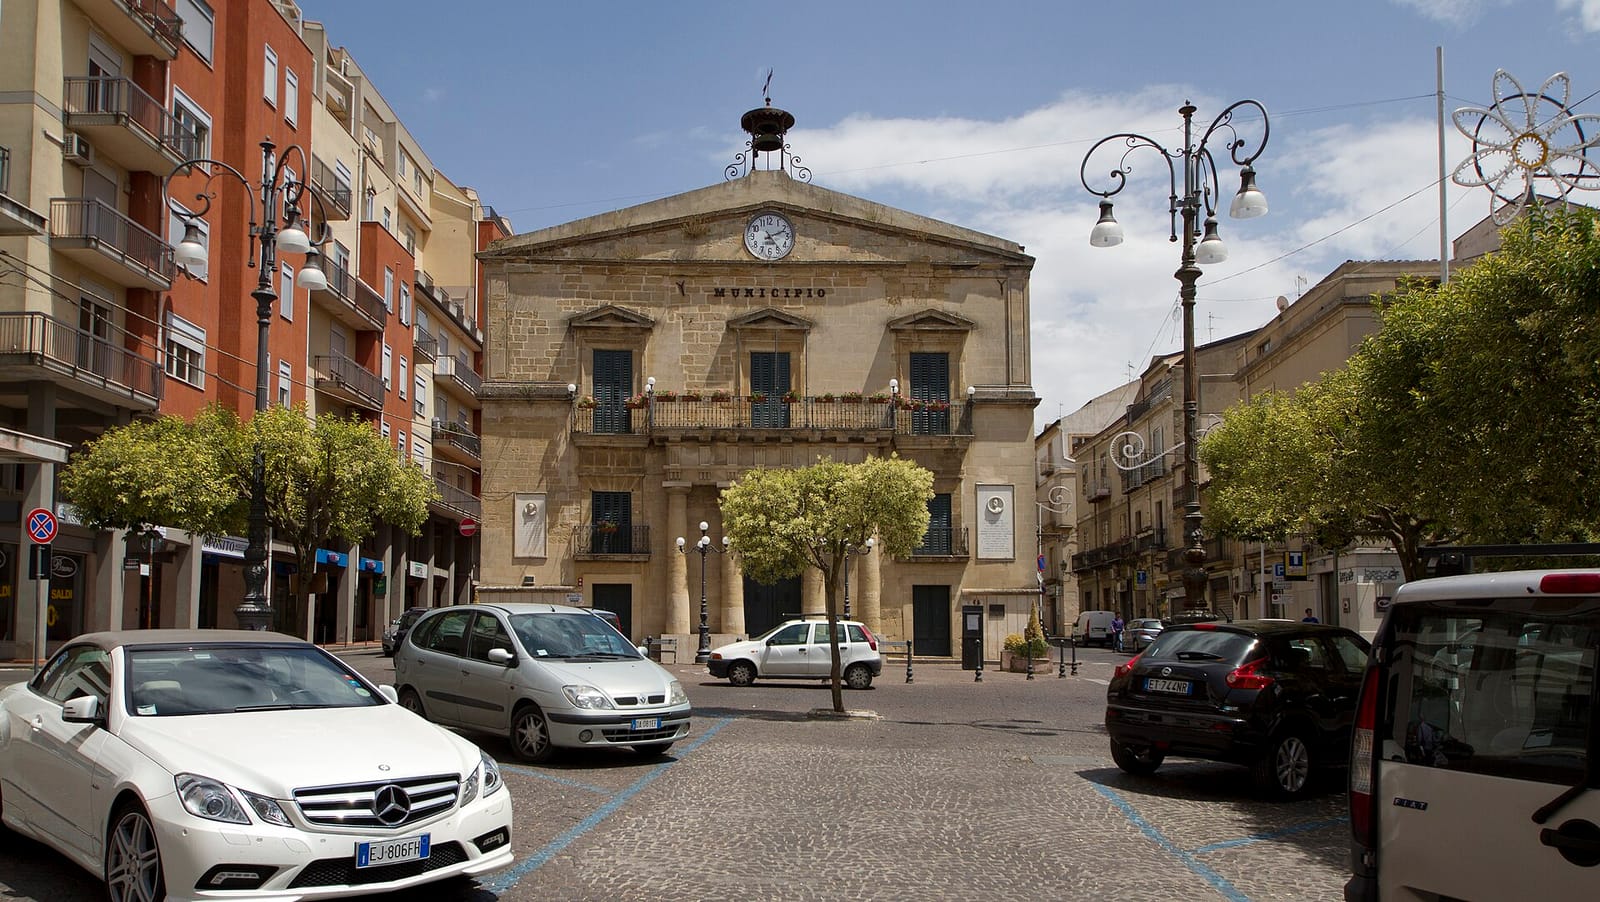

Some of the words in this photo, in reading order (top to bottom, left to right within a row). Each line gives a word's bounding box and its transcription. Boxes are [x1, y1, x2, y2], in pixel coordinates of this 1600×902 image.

[714, 288, 826, 298] MUNICIPIO
[51, 589, 73, 600] SALDI
[1395, 798, 1425, 809] FIAT
